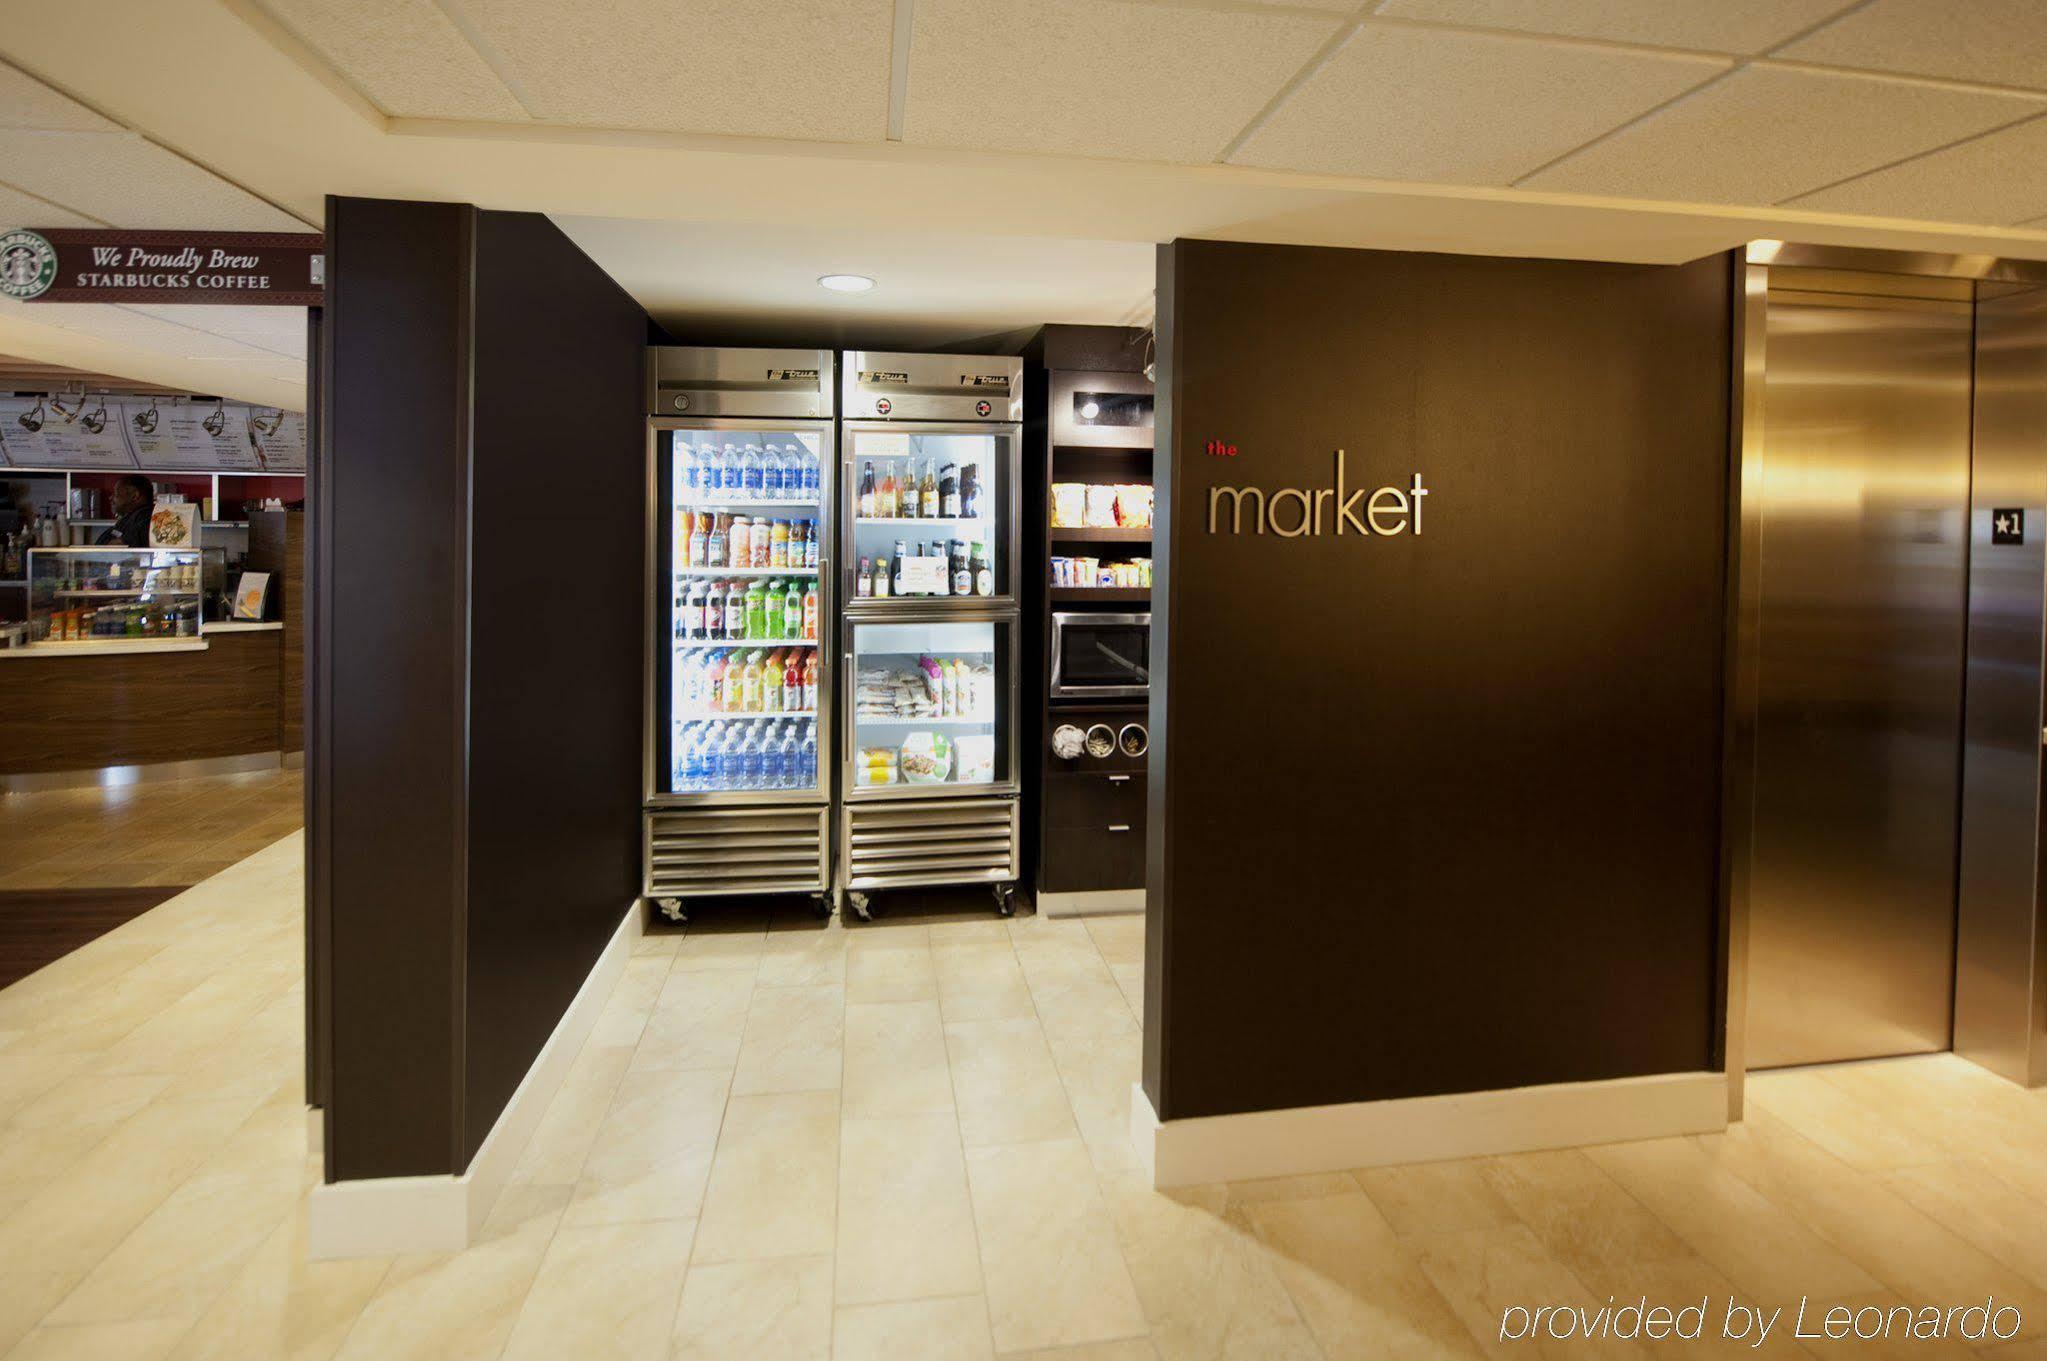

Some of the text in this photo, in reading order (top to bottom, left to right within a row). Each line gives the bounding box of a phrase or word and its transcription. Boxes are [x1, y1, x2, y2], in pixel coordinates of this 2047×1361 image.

[92, 247, 260, 274] We Proudly Brew
[77, 272, 271, 289] STARBUCKS COFFEE
[1207, 440, 1238, 456] the
[1209, 449, 1428, 538] market
